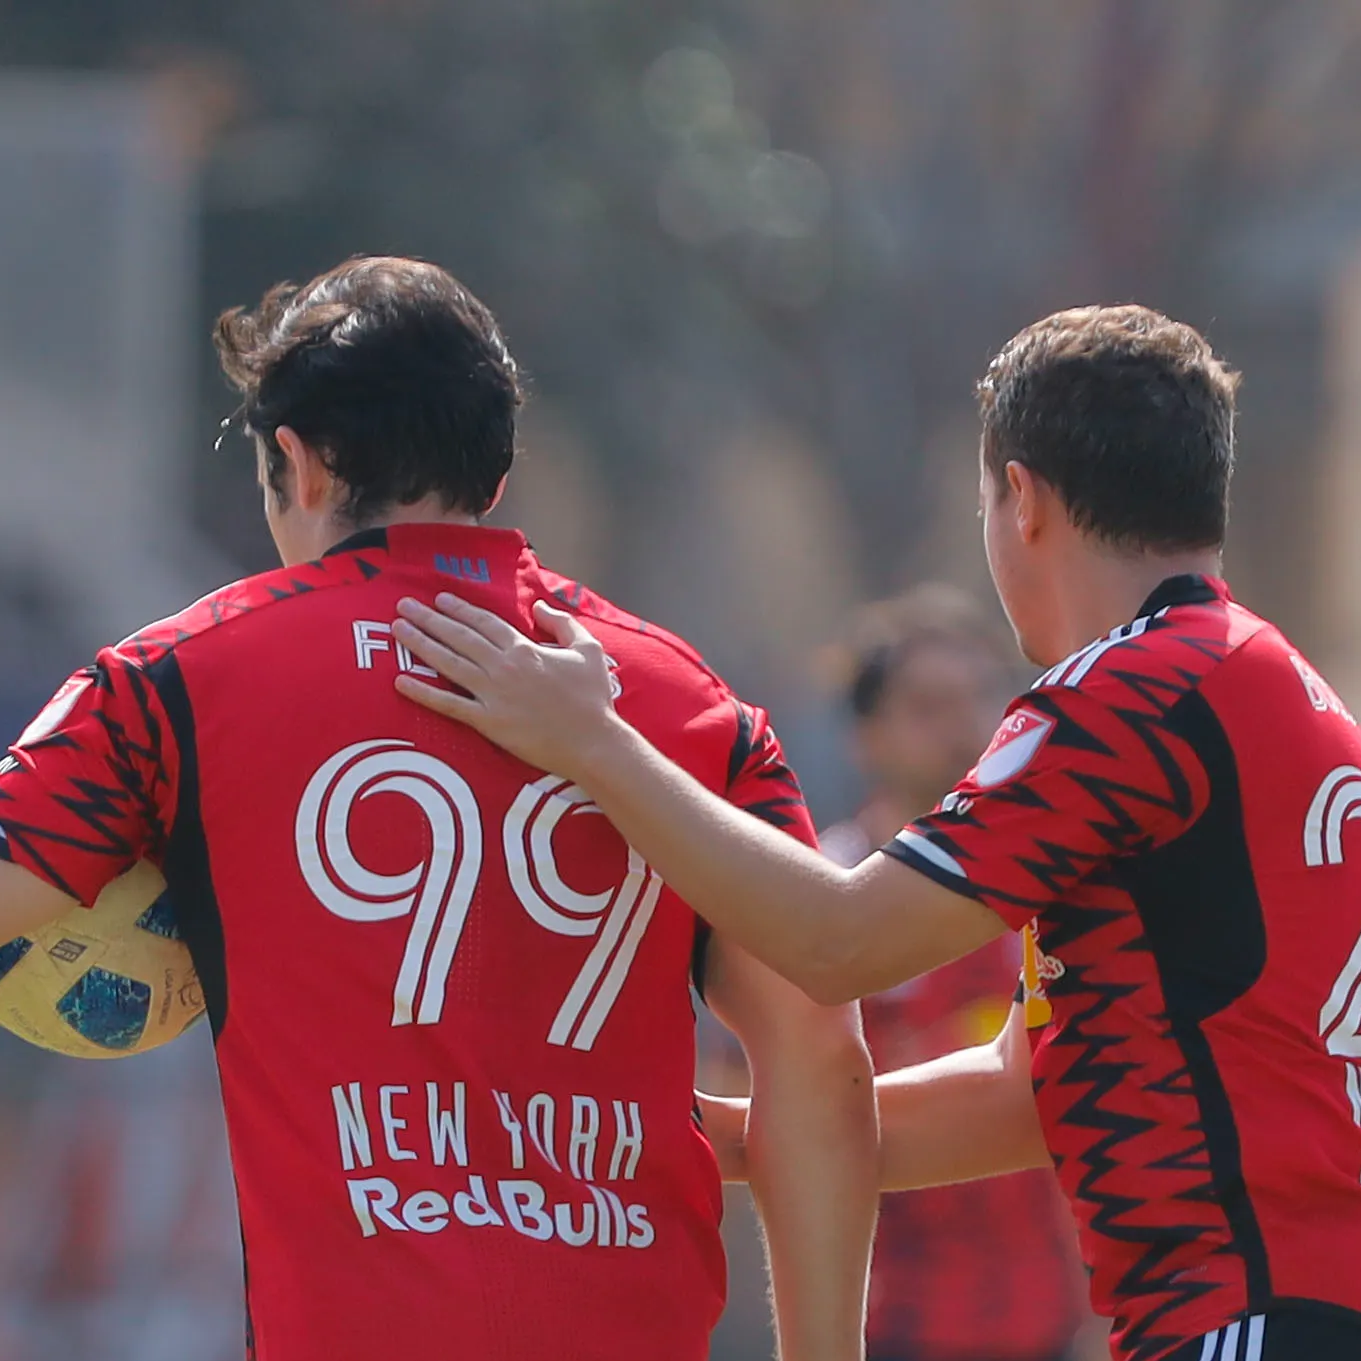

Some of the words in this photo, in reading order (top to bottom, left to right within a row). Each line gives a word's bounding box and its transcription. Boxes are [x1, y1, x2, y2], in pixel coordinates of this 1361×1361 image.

[295, 738, 662, 1051] 99
[331, 1082, 469, 1171] NEW
[490, 1088, 644, 1181] YORK
